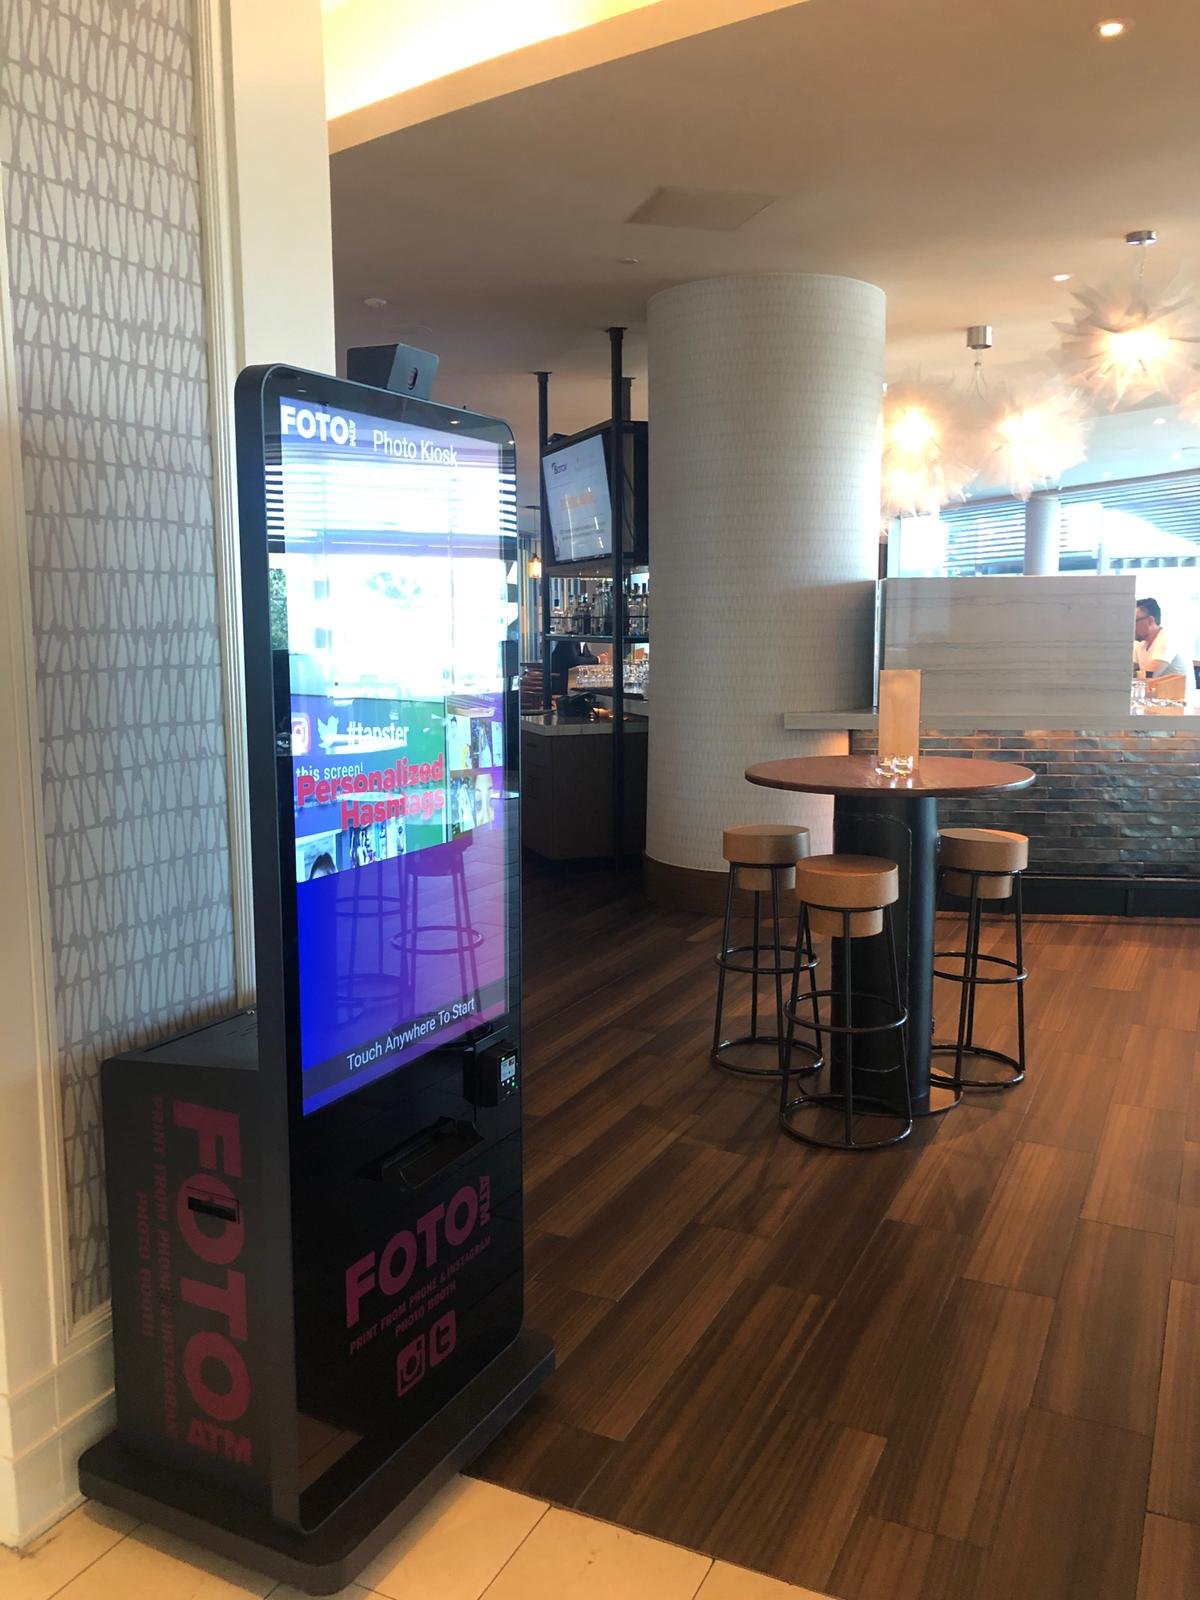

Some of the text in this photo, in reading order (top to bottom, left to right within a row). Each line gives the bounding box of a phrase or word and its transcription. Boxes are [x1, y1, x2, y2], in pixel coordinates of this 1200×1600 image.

[280, 405, 349, 445] FOTO
[373, 429, 458, 468] Photo Kiosk
[296, 762, 364, 781] this screen!
[296, 753, 444, 808] Personalized
[347, 997, 475, 1071] Touch Anywhere To Start
[152, 1095, 166, 1158] PRINT
[153, 1163, 168, 1222] FROM
[173, 1100, 252, 1422] FOTO
[345, 1186, 478, 1329] FOTO
[350, 1324, 378, 1355] PRINT
[380, 1301, 407, 1331] FROM
[409, 1279, 438, 1308] PHONE
[395, 1306, 425, 1337] PHOTO
